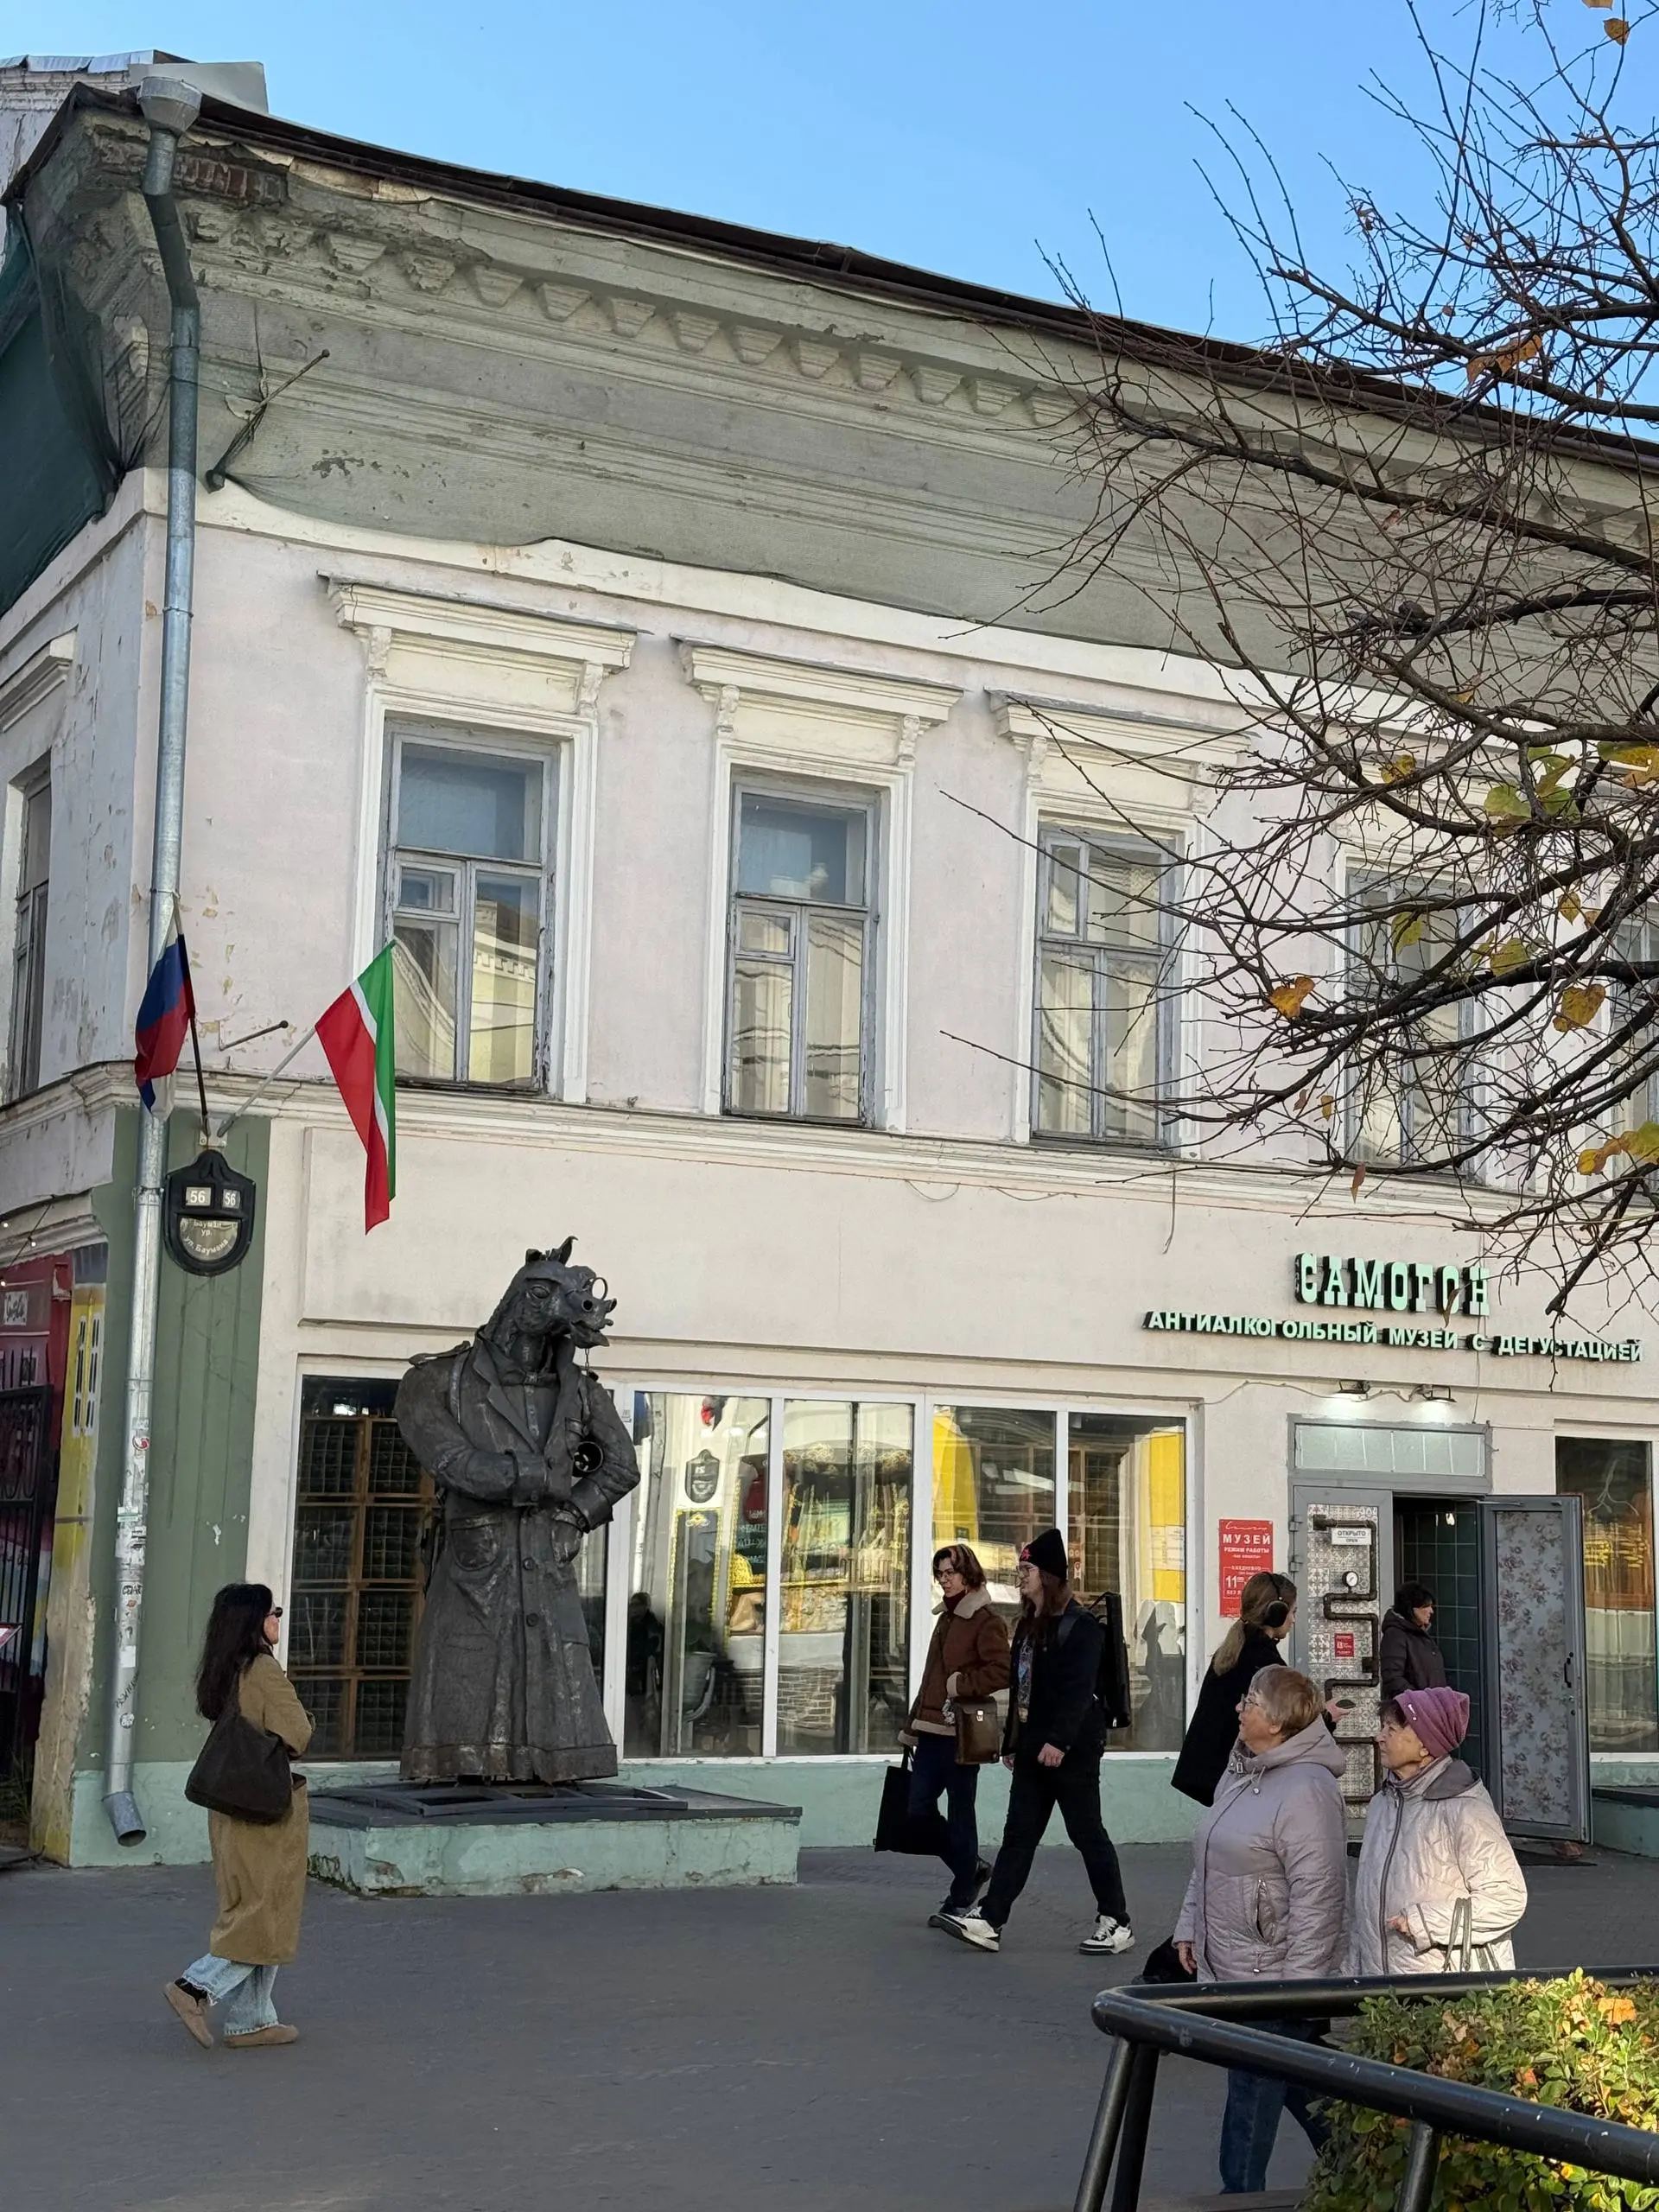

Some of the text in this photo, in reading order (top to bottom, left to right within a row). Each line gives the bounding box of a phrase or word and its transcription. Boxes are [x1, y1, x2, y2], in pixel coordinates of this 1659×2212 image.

[190, 1190, 206, 1204] 56
[225, 1192, 236, 1206] 56
[194, 1238, 229, 1256] Баумана
[1298, 1252, 1490, 1316] САМОГОН
[1146, 1311, 1377, 1344] АНТИАЛКОГОЛЬНЫЙ
[1497, 1335, 1641, 1363] ДЕГУСТАЦИЕЙ
[1223, 1533, 1271, 1545] МУЗЕЙ
[1226, 1575, 1237, 1589] 11
